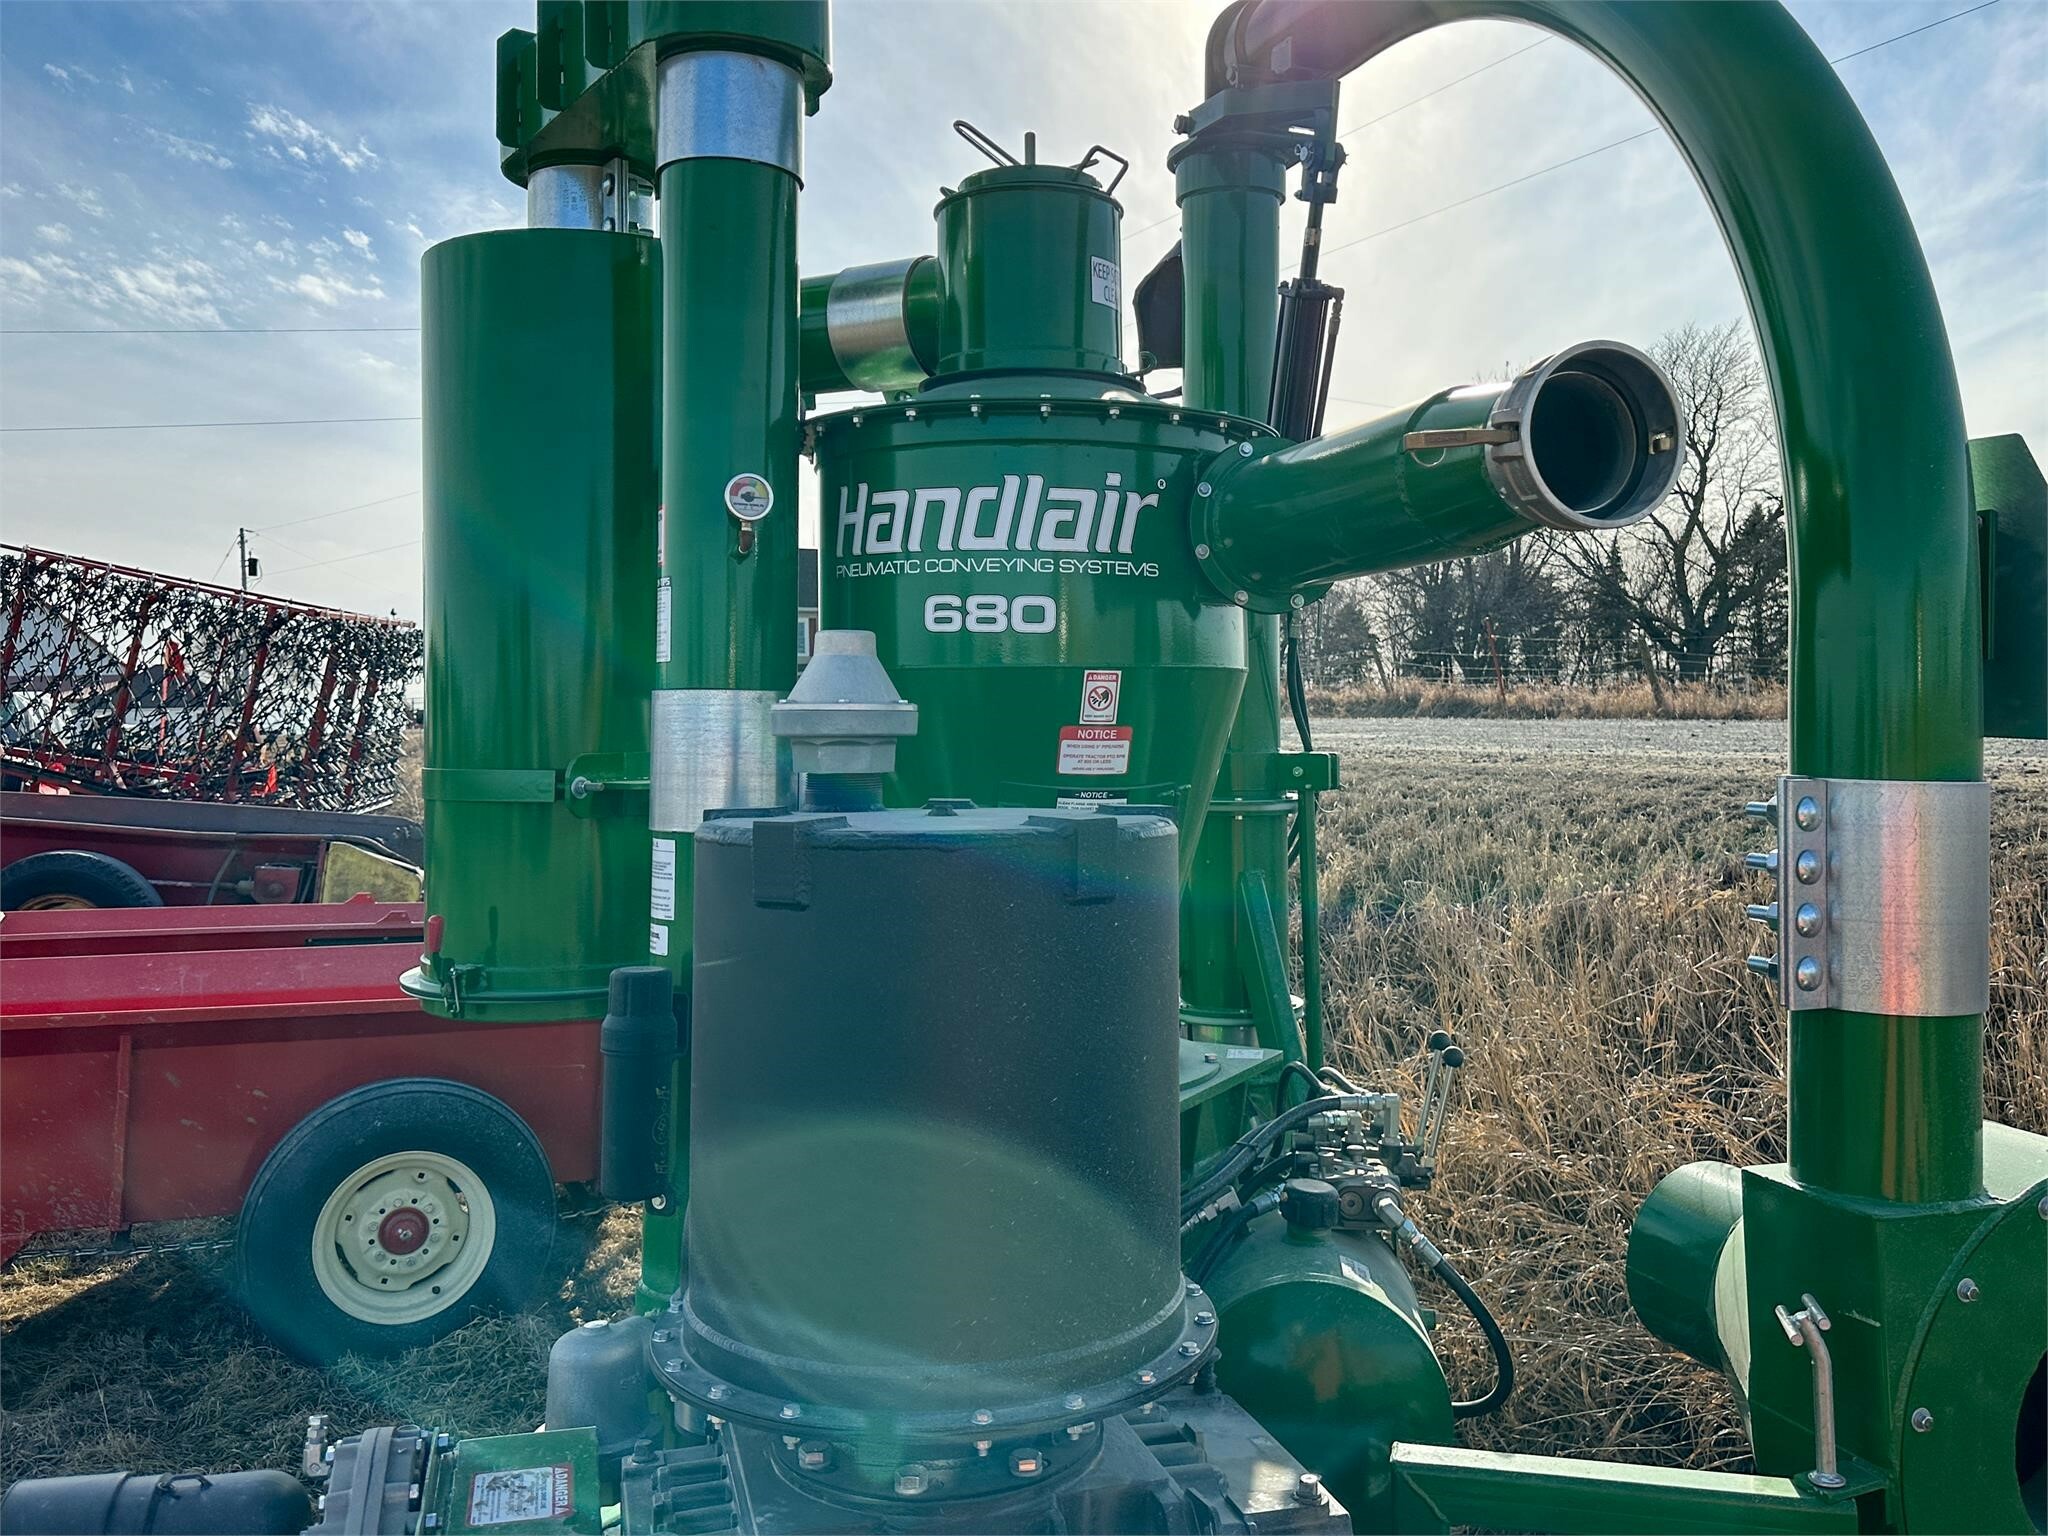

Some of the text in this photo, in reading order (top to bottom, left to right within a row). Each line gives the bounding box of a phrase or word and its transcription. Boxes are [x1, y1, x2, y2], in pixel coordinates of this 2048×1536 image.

[836, 472, 1160, 558] Handlair
[836, 557, 1159, 579] PNEUMATIC CONVEYING SYSTEMS
[924, 594, 1057, 633] 680
[1077, 729, 1118, 739] NOTICE
[1080, 791, 1109, 799] NOTICE
[555, 1474, 569, 1509] DANGER
